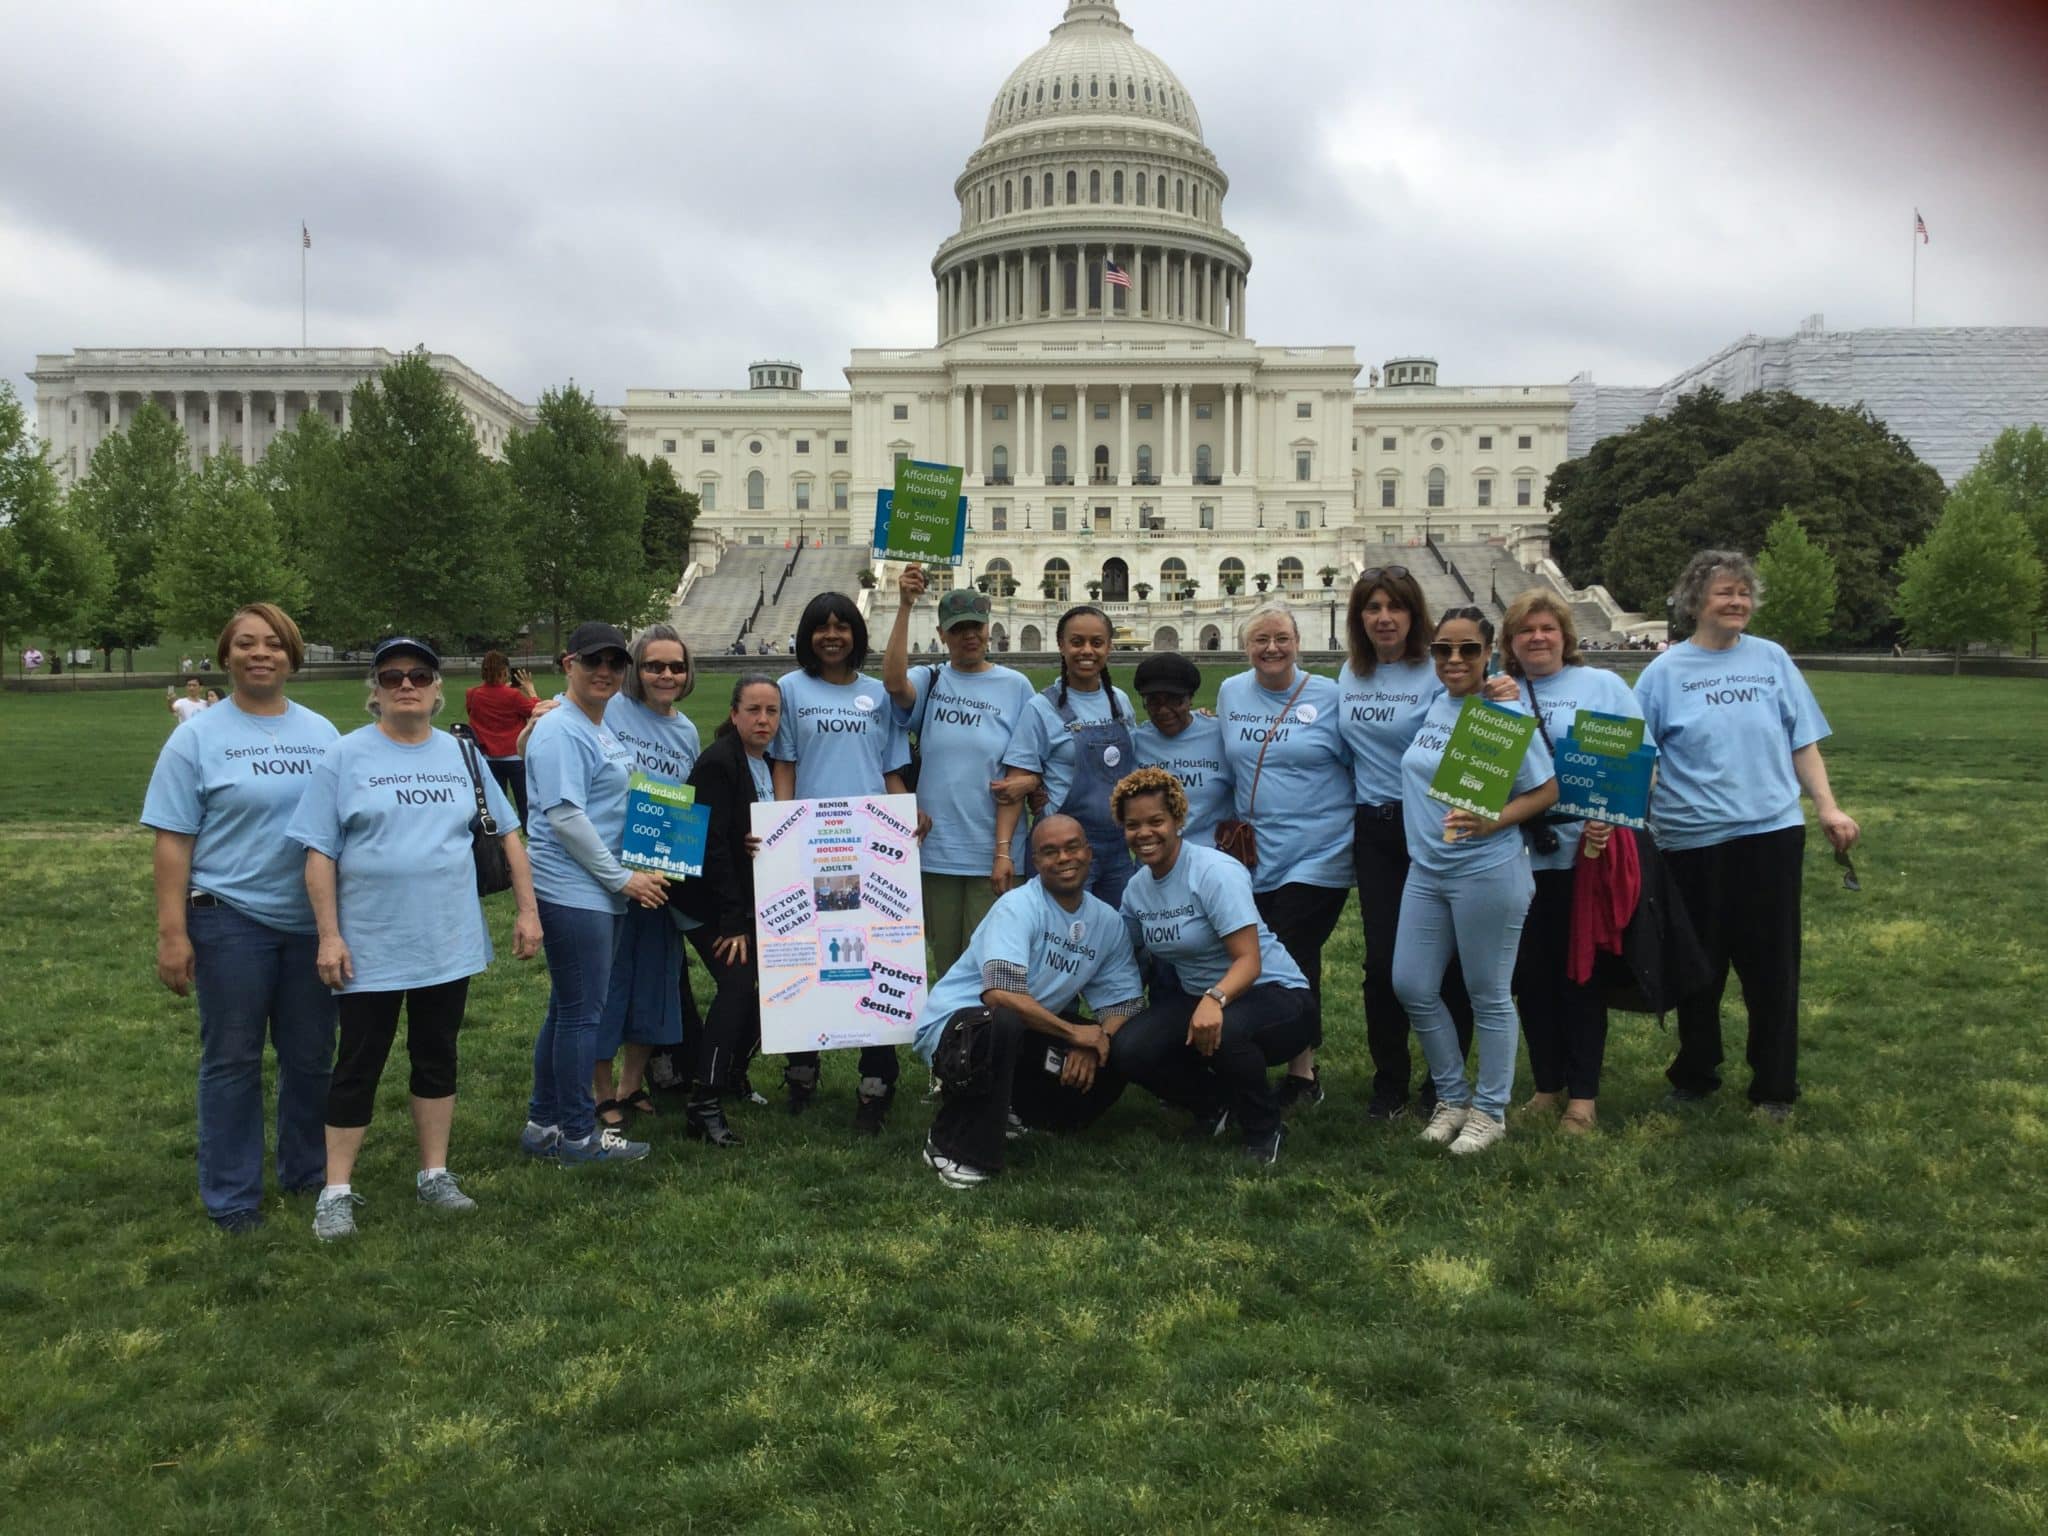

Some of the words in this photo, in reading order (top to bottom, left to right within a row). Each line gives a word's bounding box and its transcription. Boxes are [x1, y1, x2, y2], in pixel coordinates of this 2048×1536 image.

[903, 469, 955, 485] Affordable
[906, 483, 948, 499] Housing
[896, 509, 910, 519] for
[914, 512, 950, 525] Seniors
[1681, 678, 1721, 692] Senior
[1726, 675, 1776, 686] Housing
[1344, 692, 1374, 703] Senior
[1375, 691, 1419, 705] Housing
[1705, 687, 1760, 705] NOW!
[957, 696, 1001, 715] Housing
[1350, 706, 1396, 722] NOW!
[798, 706, 834, 718] Senior
[838, 707, 879, 724] Housing
[934, 707, 982, 727] NOW!
[1229, 711, 1262, 723] Senior
[1265, 714, 1311, 726] Housi
[1468, 707, 1526, 735] Affordable
[817, 719, 866, 735] NOW!
[1240, 728, 1289, 742] NOW!
[1468, 722, 1514, 749] Housing
[1580, 721, 1633, 738] Affordable
[618, 731, 650, 749] Senior
[225, 746, 269, 760] Senior
[1564, 752, 1597, 766] GOOD
[252, 760, 312, 775] NOW!
[636, 750, 680, 778] NOW!
[1174, 759, 1219, 772] Housing
[1450, 747, 1466, 761] for
[1469, 755, 1511, 778] Seniors
[369, 775, 412, 788] Senior
[416, 773, 468, 787] Housing
[1172, 772, 1203, 787] W!
[1459, 776, 1485, 792] NOW
[1561, 774, 1594, 788] GOOD
[395, 788, 456, 805] NOW!
[637, 782, 689, 802] Affordable
[636, 802, 665, 817] GOOD
[818, 801, 849, 809] SENIOR
[766, 805, 807, 846] PROTECT!!
[865, 803, 912, 836] SUPPORT!!
[632, 824, 661, 838] GOOD
[817, 828, 852, 836] EXPAND
[808, 836, 862, 845] AFFORDABLE
[870, 842, 904, 860] 2019
[820, 864, 853, 872] ADULTS
[869, 872, 908, 899] EXPAND
[760, 904, 778, 919] LET
[778, 889, 807, 907] YOUR
[864, 882, 912, 913] AFFORDABLE
[767, 907, 798, 927] VOICE
[797, 899, 810, 911] BE
[861, 893, 903, 921] HOUSING
[777, 912, 811, 935] HEARD
[1145, 923, 1181, 943] NOW!
[1045, 950, 1080, 976] NOW!
[870, 961, 923, 985] Protect
[878, 983, 906, 999] Our
[861, 997, 912, 1020] Seniors
